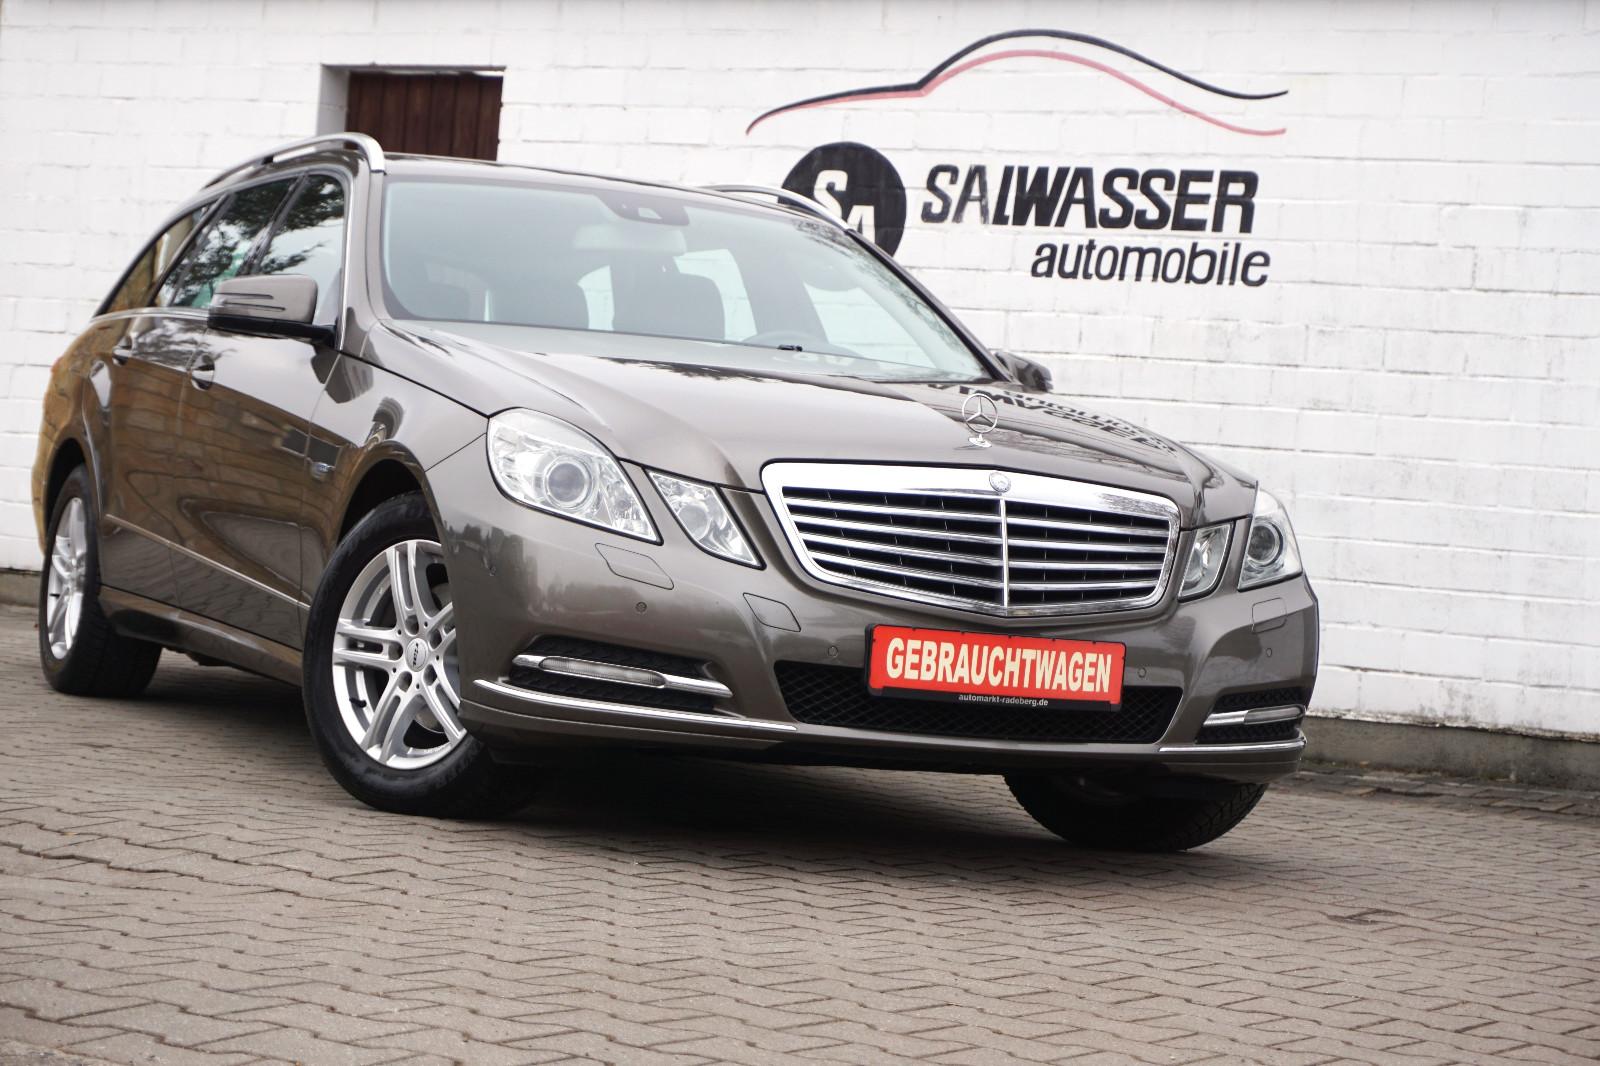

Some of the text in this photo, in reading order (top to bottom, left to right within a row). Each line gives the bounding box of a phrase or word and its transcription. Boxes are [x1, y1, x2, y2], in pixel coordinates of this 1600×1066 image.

[920, 163, 1260, 234] SALWASSER
[1030, 239, 1271, 287] automobile
[886, 637, 1112, 693] GEBRAUCHTWAGEN
